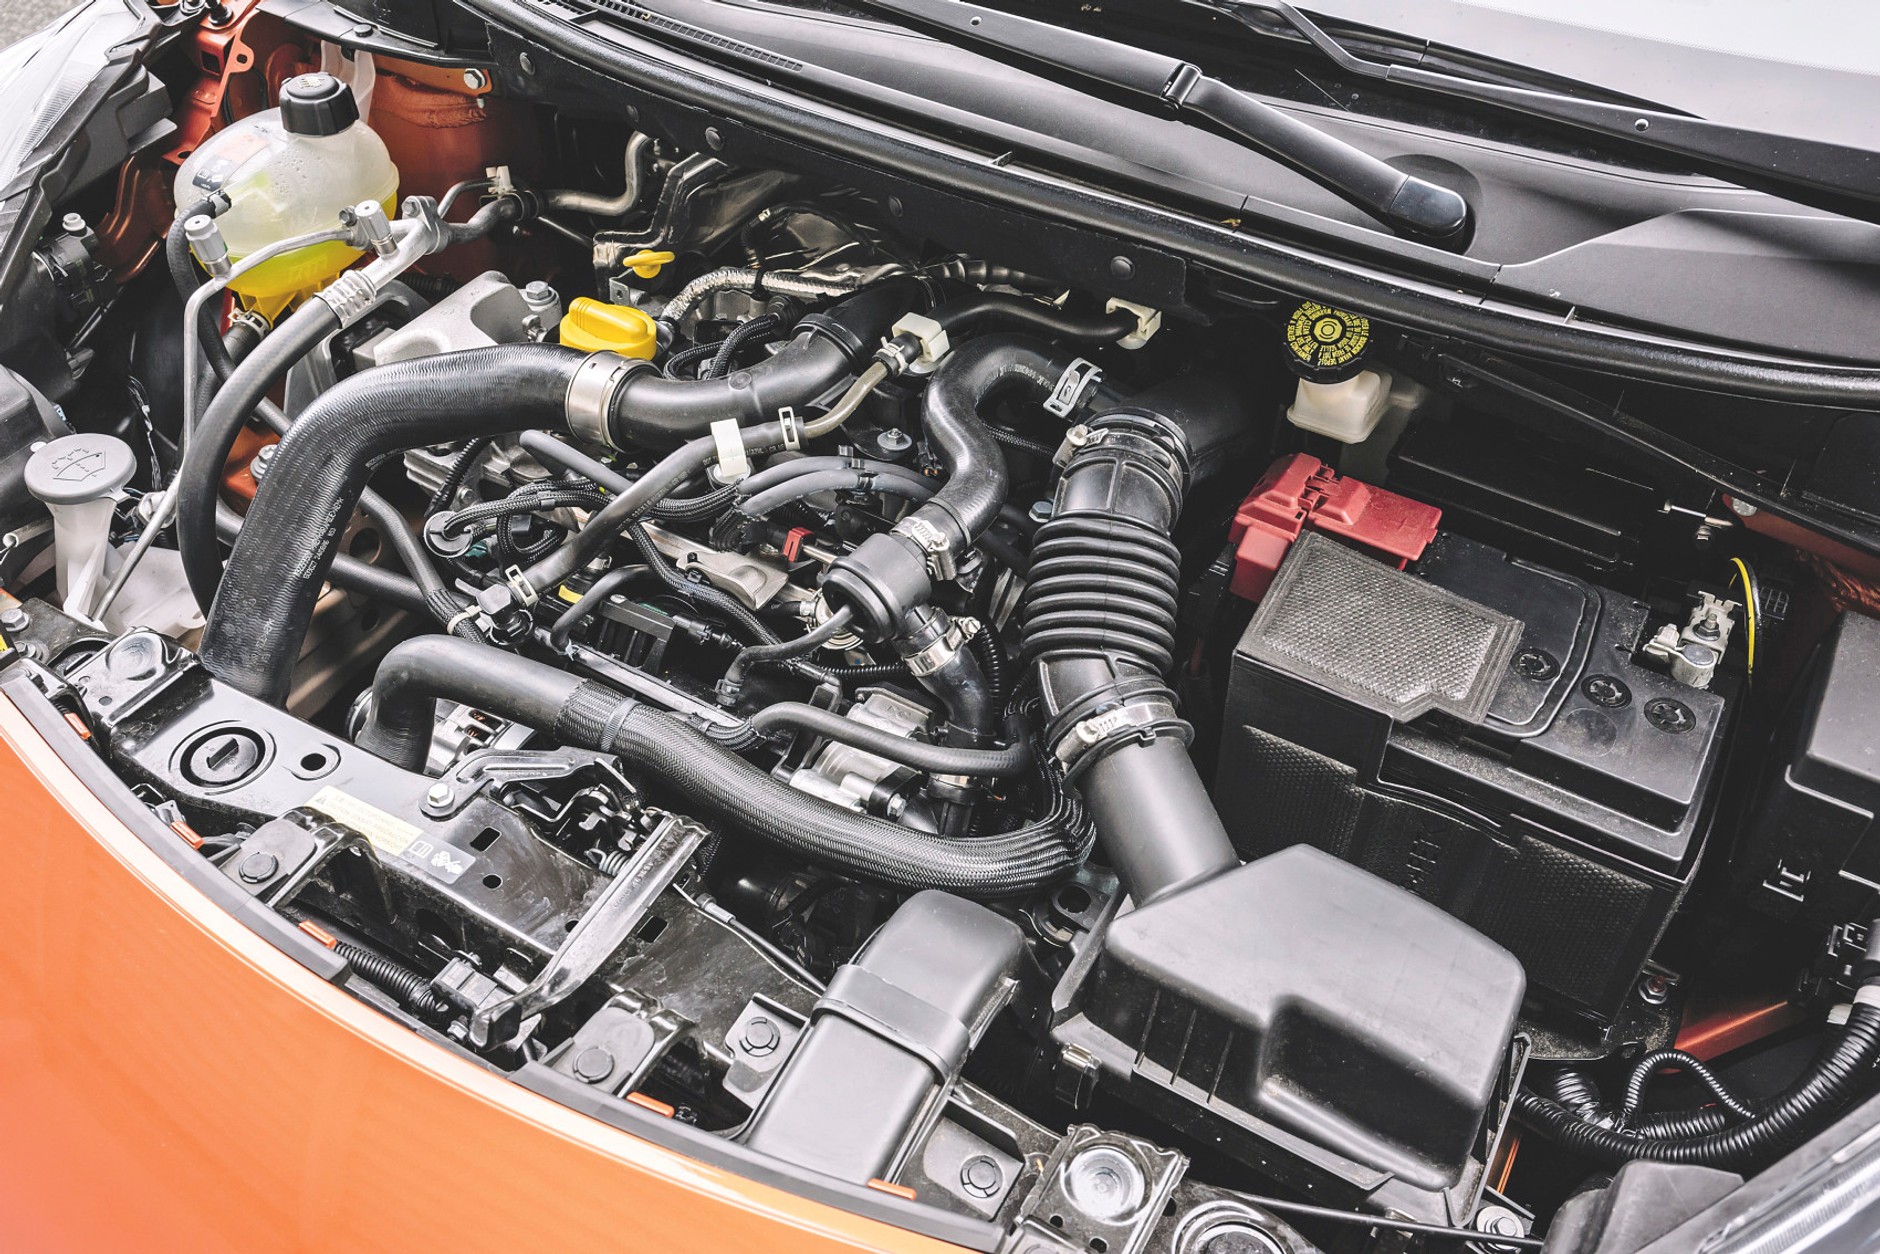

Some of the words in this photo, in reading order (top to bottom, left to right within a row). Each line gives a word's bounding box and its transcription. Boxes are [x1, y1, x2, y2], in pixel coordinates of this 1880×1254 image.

[1287, 325, 1296, 342] SEALED
[1303, 320, 1312, 335] CLEAN
[1352, 337, 1367, 355] BOUCHON
